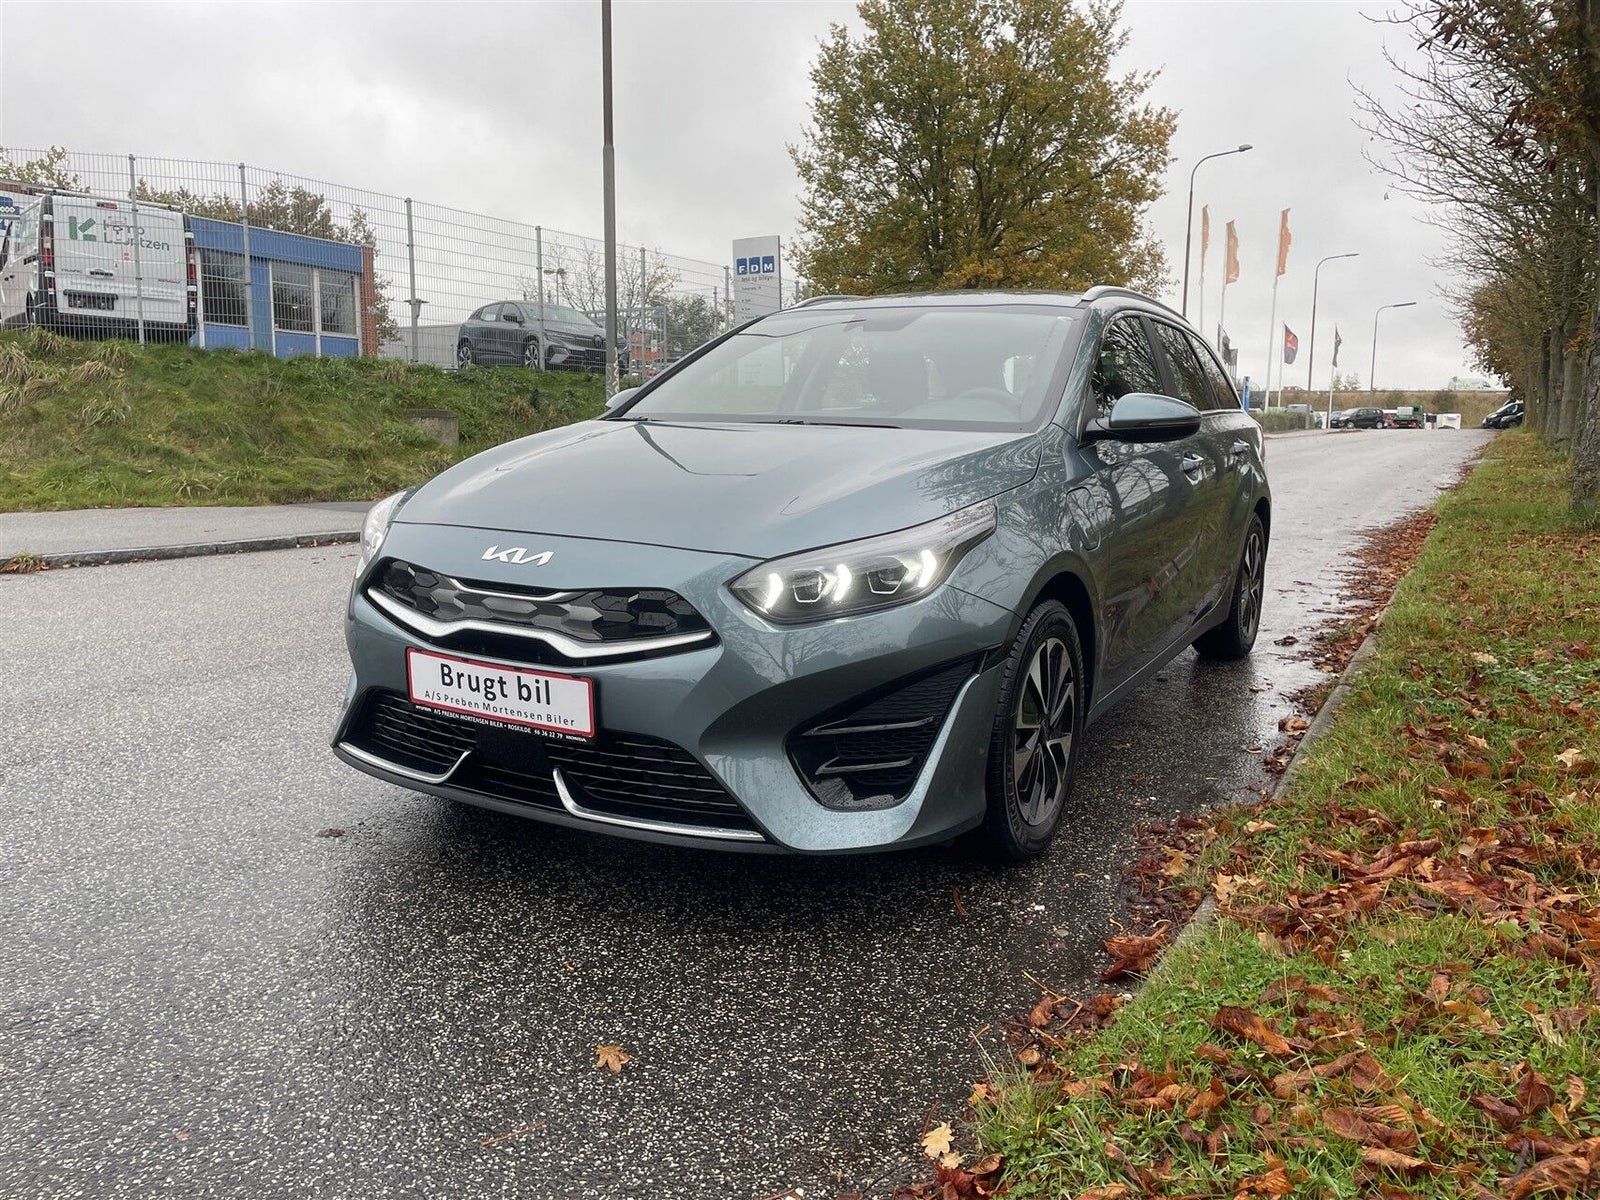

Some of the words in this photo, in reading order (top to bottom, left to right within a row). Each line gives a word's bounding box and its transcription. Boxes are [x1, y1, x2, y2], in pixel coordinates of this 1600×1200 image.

[738, 260, 773, 274] FDM
[440, 663, 508, 702] Brugt
[516, 675, 551, 706] bil
[424, 690, 442, 701] A/S
[443, 694, 480, 710] Preben
[482, 702, 543, 722] Mortensen
[546, 713, 576, 727] Biler
[441, 710, 460, 719] PREBEN
[460, 714, 489, 725] MORTENSEN
[489, 720, 504, 728] BILER
[507, 723, 532, 734] ROSKILDE
